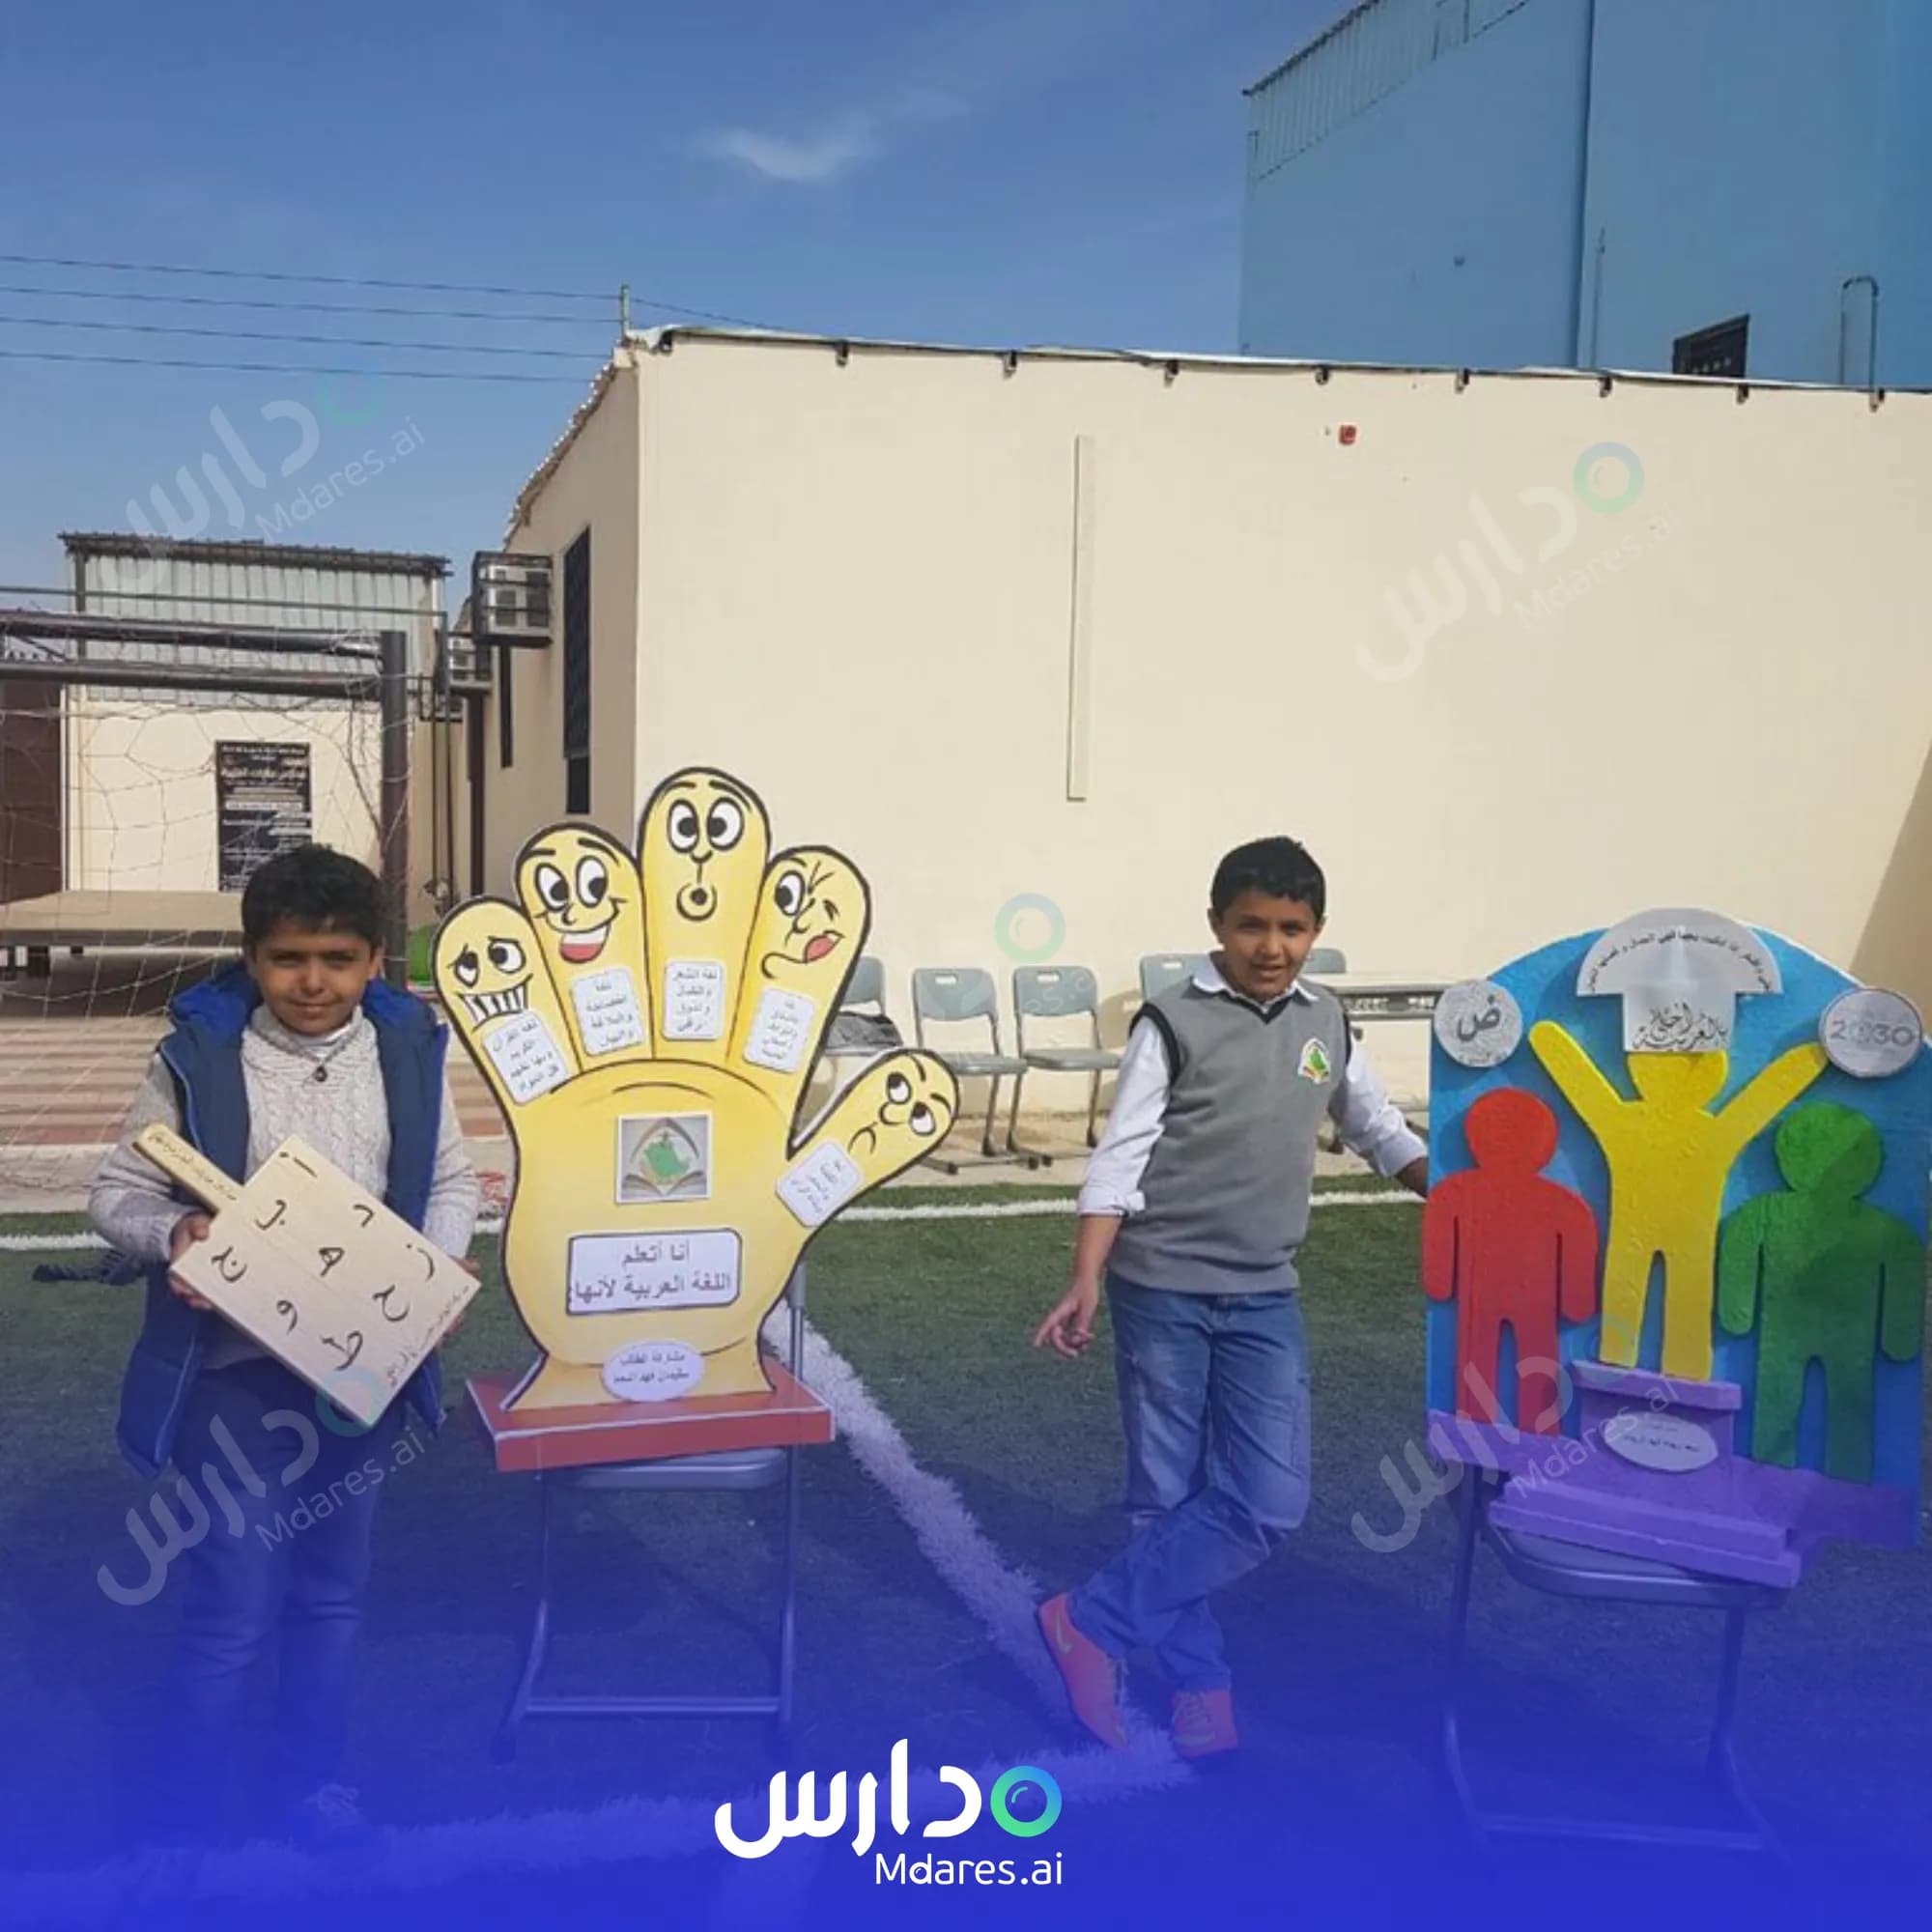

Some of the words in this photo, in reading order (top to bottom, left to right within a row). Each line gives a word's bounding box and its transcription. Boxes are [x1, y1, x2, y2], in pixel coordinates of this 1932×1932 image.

[1456, 993, 1502, 1041] ض
[256, 1199, 287, 1231] ب
[353, 1204, 375, 1229] د
[211, 1246, 248, 1283] ج
[406, 1242, 436, 1282] ز
[622, 1240, 663, 1267] أتعلم
[670, 1239, 690, 1261] أنا
[575, 1276, 616, 1304] لأنها
[624, 1274, 685, 1301] العربية
[692, 1270, 731, 1292] اللغة
[276, 1299, 298, 1334] و
[372, 1284, 411, 1322] ح
[320, 1330, 364, 1371] ط
